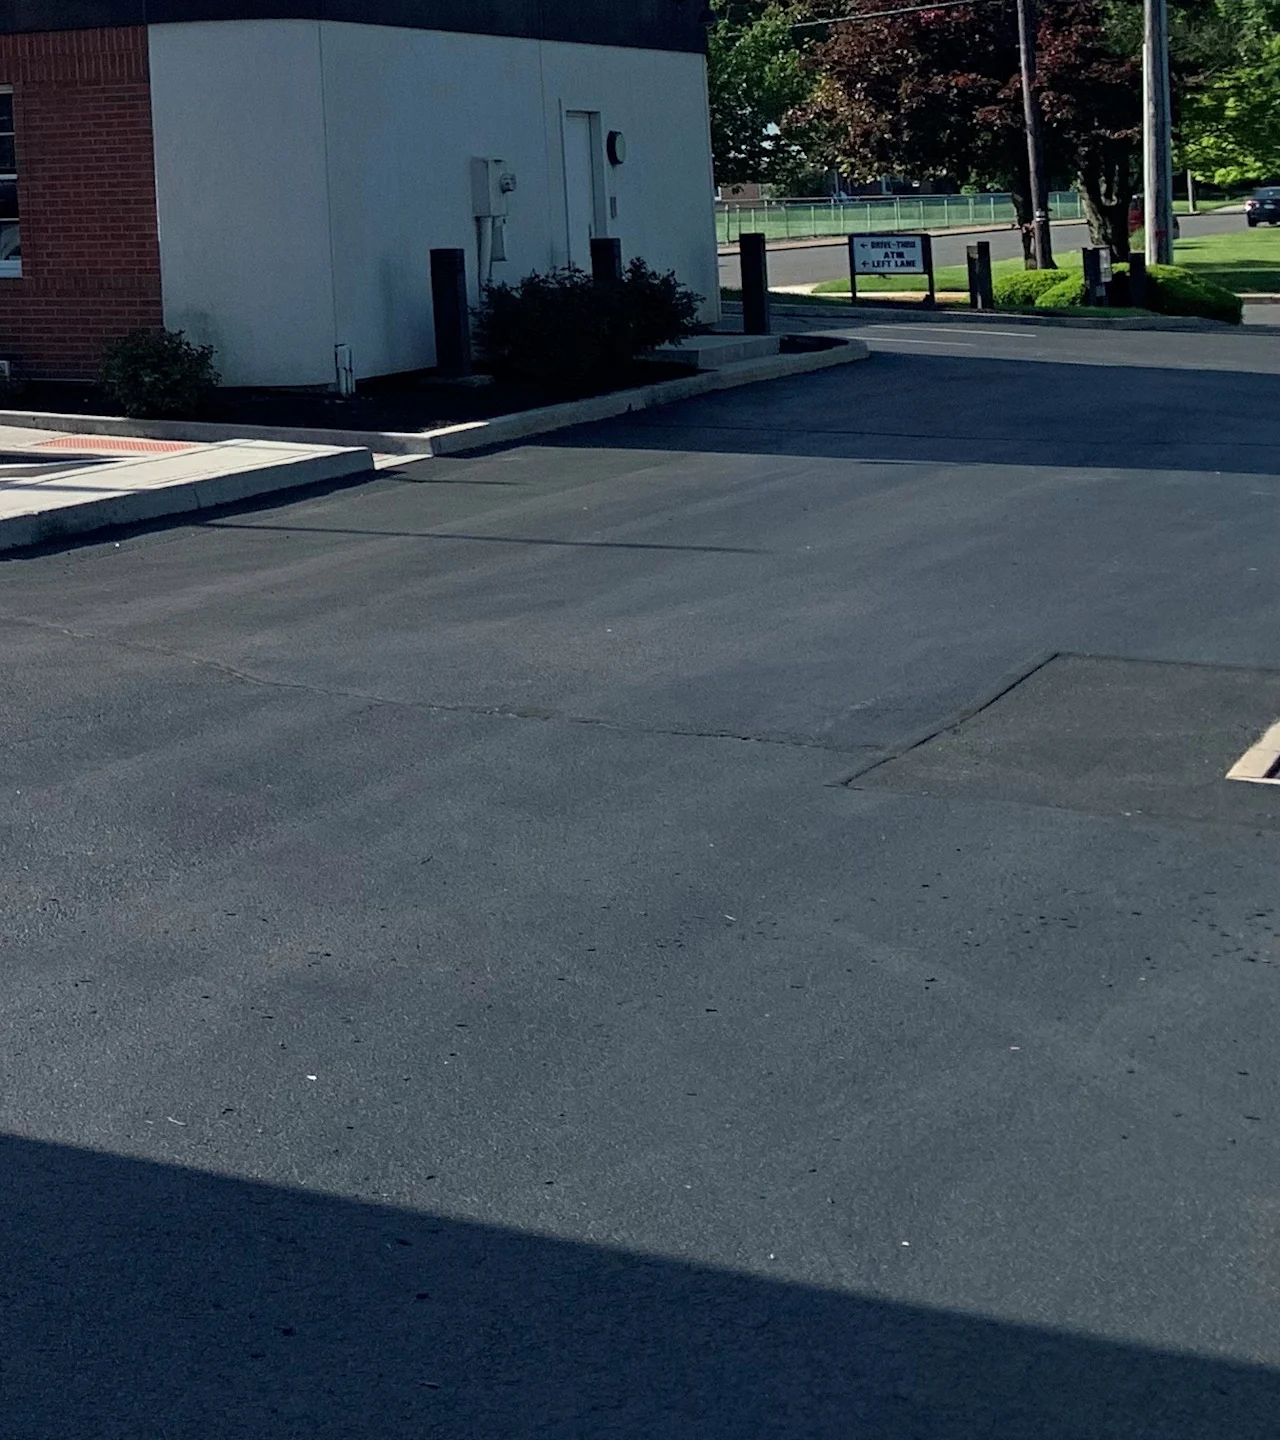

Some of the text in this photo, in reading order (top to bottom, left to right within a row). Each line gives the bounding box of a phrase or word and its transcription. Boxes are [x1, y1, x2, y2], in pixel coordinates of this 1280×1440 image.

[884, 251, 905, 259] ATM
[872, 260, 916, 268] LEFT LANE
